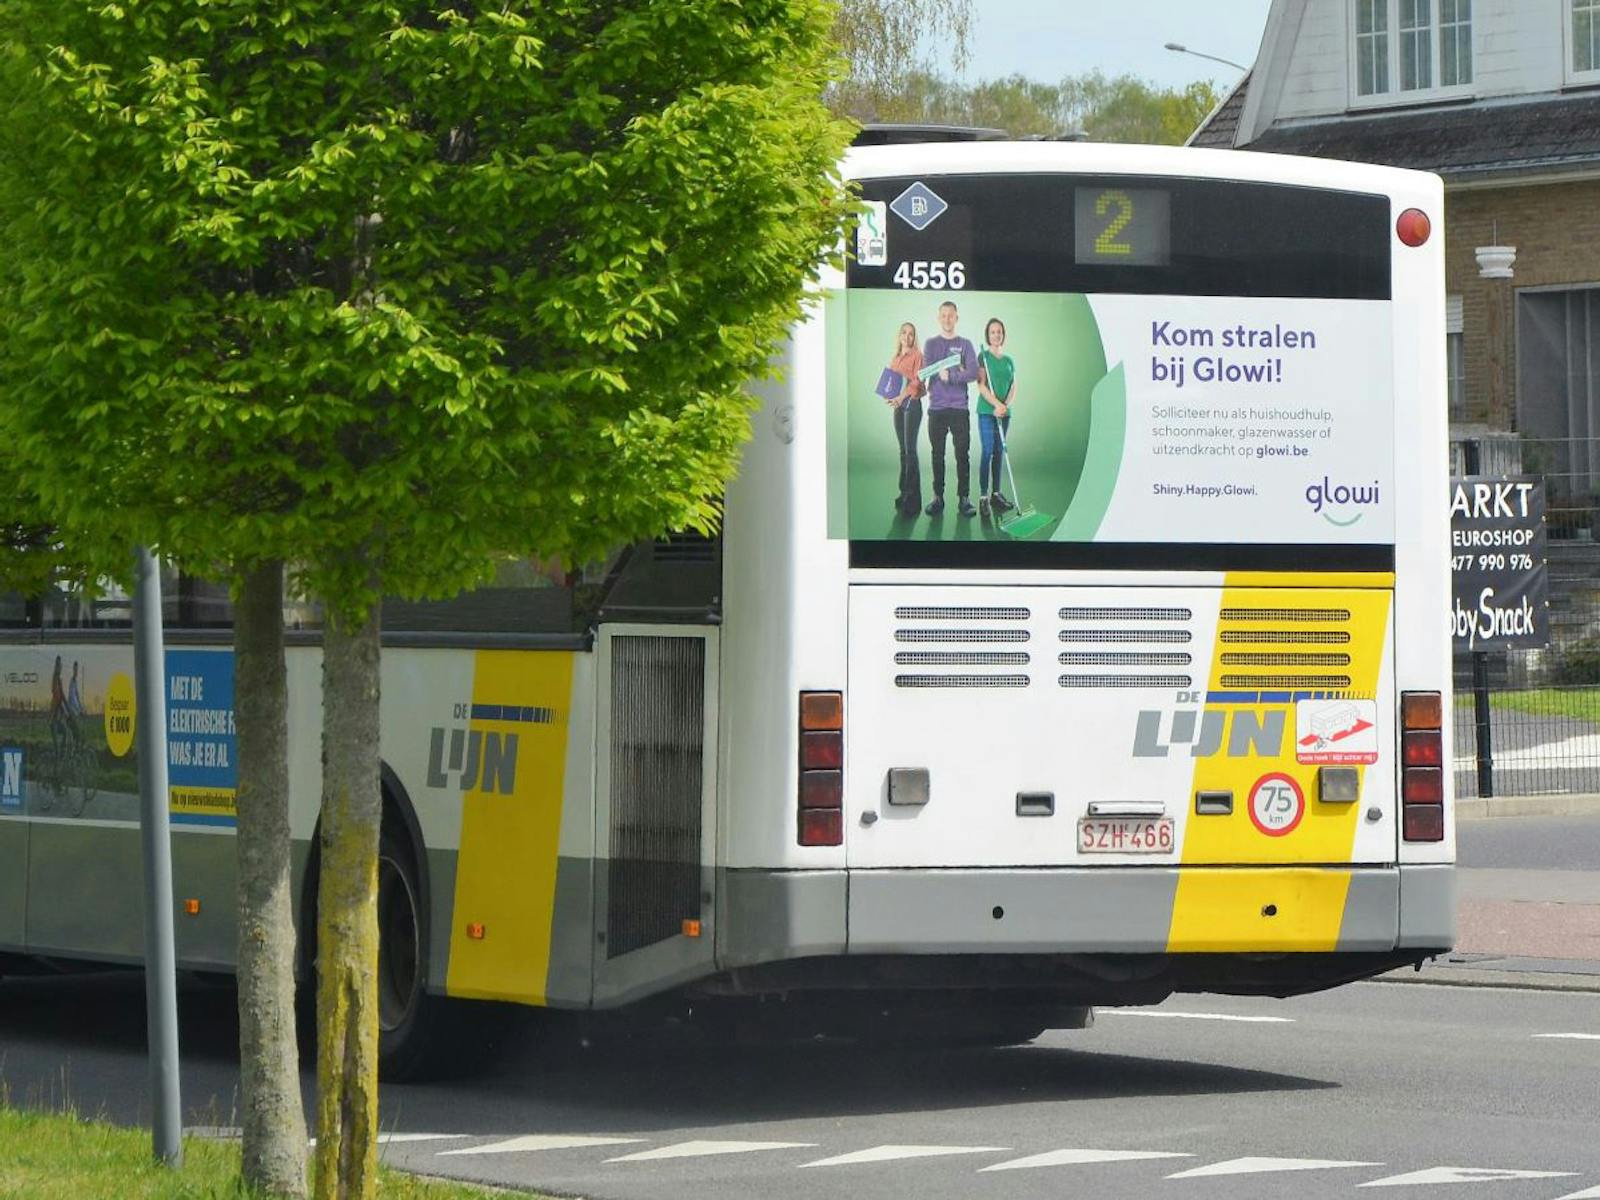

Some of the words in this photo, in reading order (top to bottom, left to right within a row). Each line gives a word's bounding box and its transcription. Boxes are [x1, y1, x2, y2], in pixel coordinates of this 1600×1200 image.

[1095, 189, 1131, 255] 2
[893, 261, 966, 290] 4556
[1151, 321, 1213, 347] Kom
[1221, 324, 1316, 349] stralen
[1151, 356, 1185, 387] bij
[1193, 357, 1282, 383] Glowi!
[1152, 406, 1211, 419] Solliciteer
[1213, 409, 1228, 419] nu
[1231, 408, 1247, 419] als
[1249, 408, 1334, 422] huishoudhulp,
[1152, 425, 1235, 438] schoonmaker,
[1238, 425, 1316, 439] glazenwasser
[1319, 426, 1331, 438] of
[1152, 444, 1235, 456] uitzendkracht
[1238, 447, 1254, 459] op
[1306, 476, 1379, 513] glowi
[1451, 483, 1534, 518] ARKT
[1453, 529, 1534, 547] EUROSHOP
[1479, 555, 1505, 571] 990
[1510, 555, 1533, 570] 976
[171, 676, 190, 700] MET
[191, 677, 203, 701] DE
[1176, 691, 1199, 703] DE
[170, 708, 227, 734] ELEKTRISCHE
[453, 703, 468, 719] DE
[1132, 710, 1286, 757] LIJN
[170, 741, 192, 766] WAS
[192, 742, 204, 766] JE
[204, 742, 216, 767] ER
[216, 743, 229, 768] AL
[427, 727, 519, 795] LIJN
[1261, 787, 1292, 813] 75
[1268, 815, 1284, 825] km
